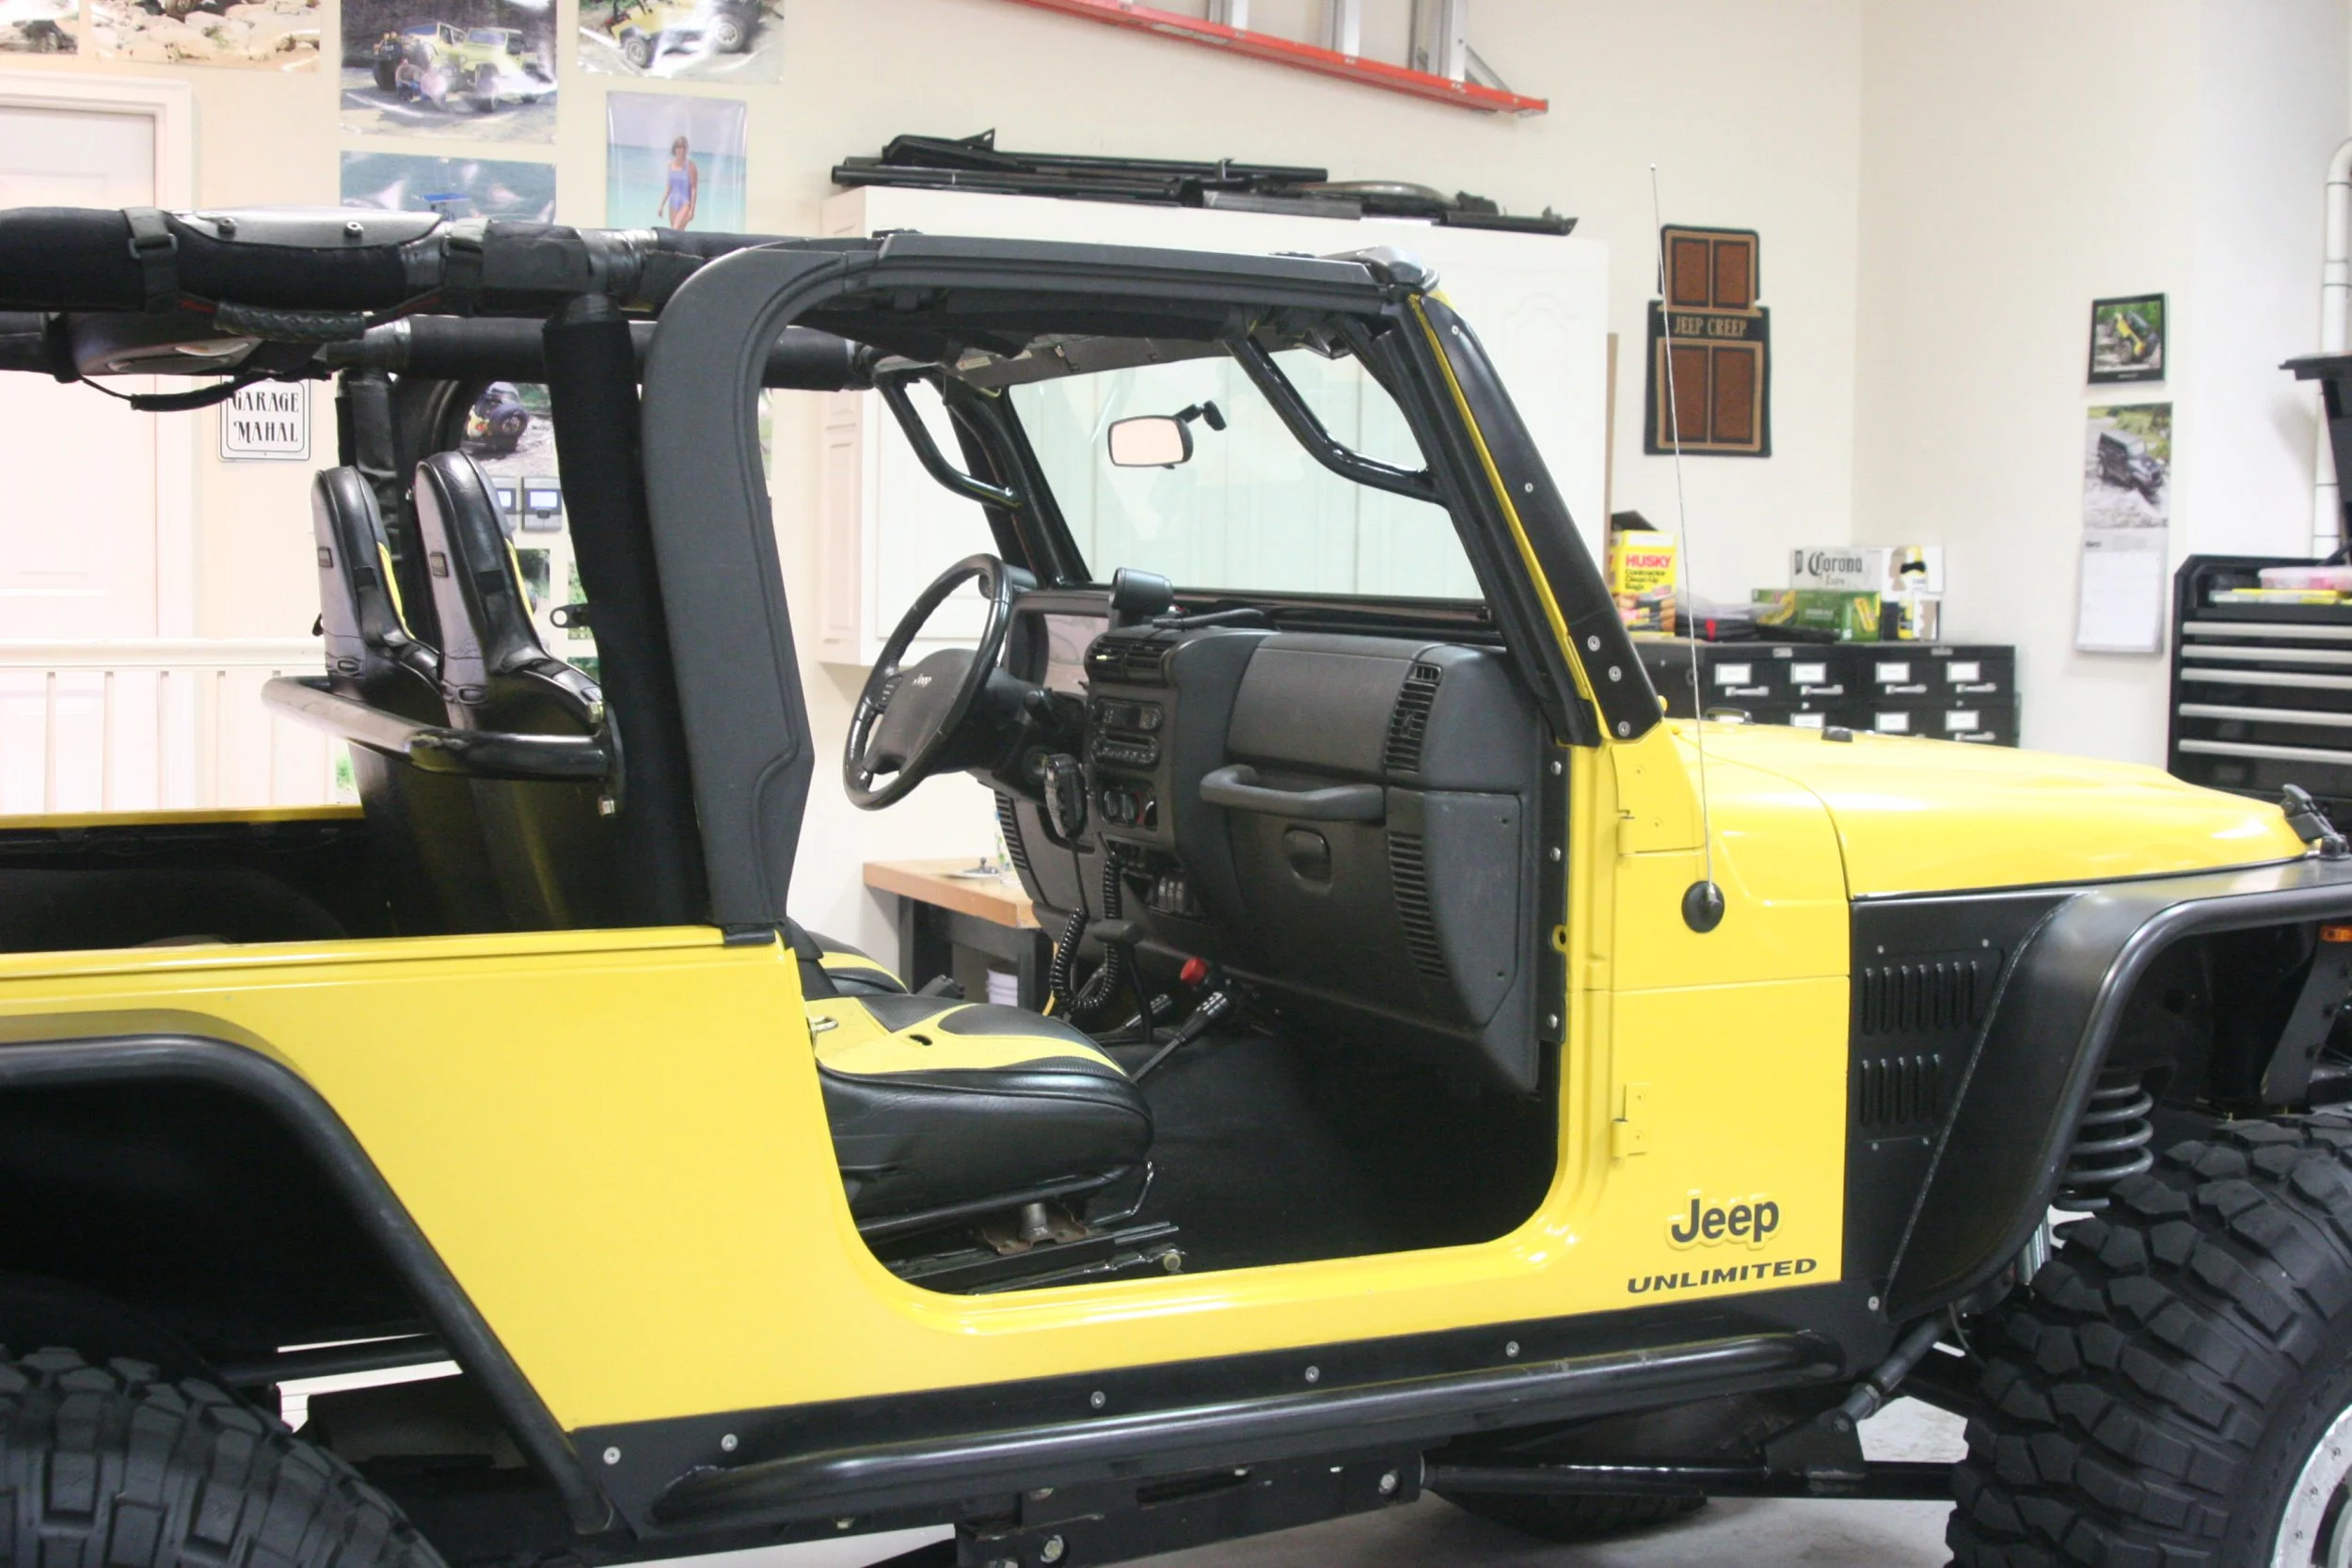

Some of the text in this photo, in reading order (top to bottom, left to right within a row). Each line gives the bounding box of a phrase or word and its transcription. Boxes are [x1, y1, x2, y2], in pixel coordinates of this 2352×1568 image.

[1675, 316, 1747, 338] JEEP CREEP
[232, 391, 299, 413] GARAGE
[233, 420, 298, 443] MAHAL
[1625, 554, 1672, 568] HUSKY
[1807, 550, 1863, 578] Corona
[1671, 1197, 1779, 1243] Jeep
[1627, 1259, 1818, 1293] UNLIMITED
